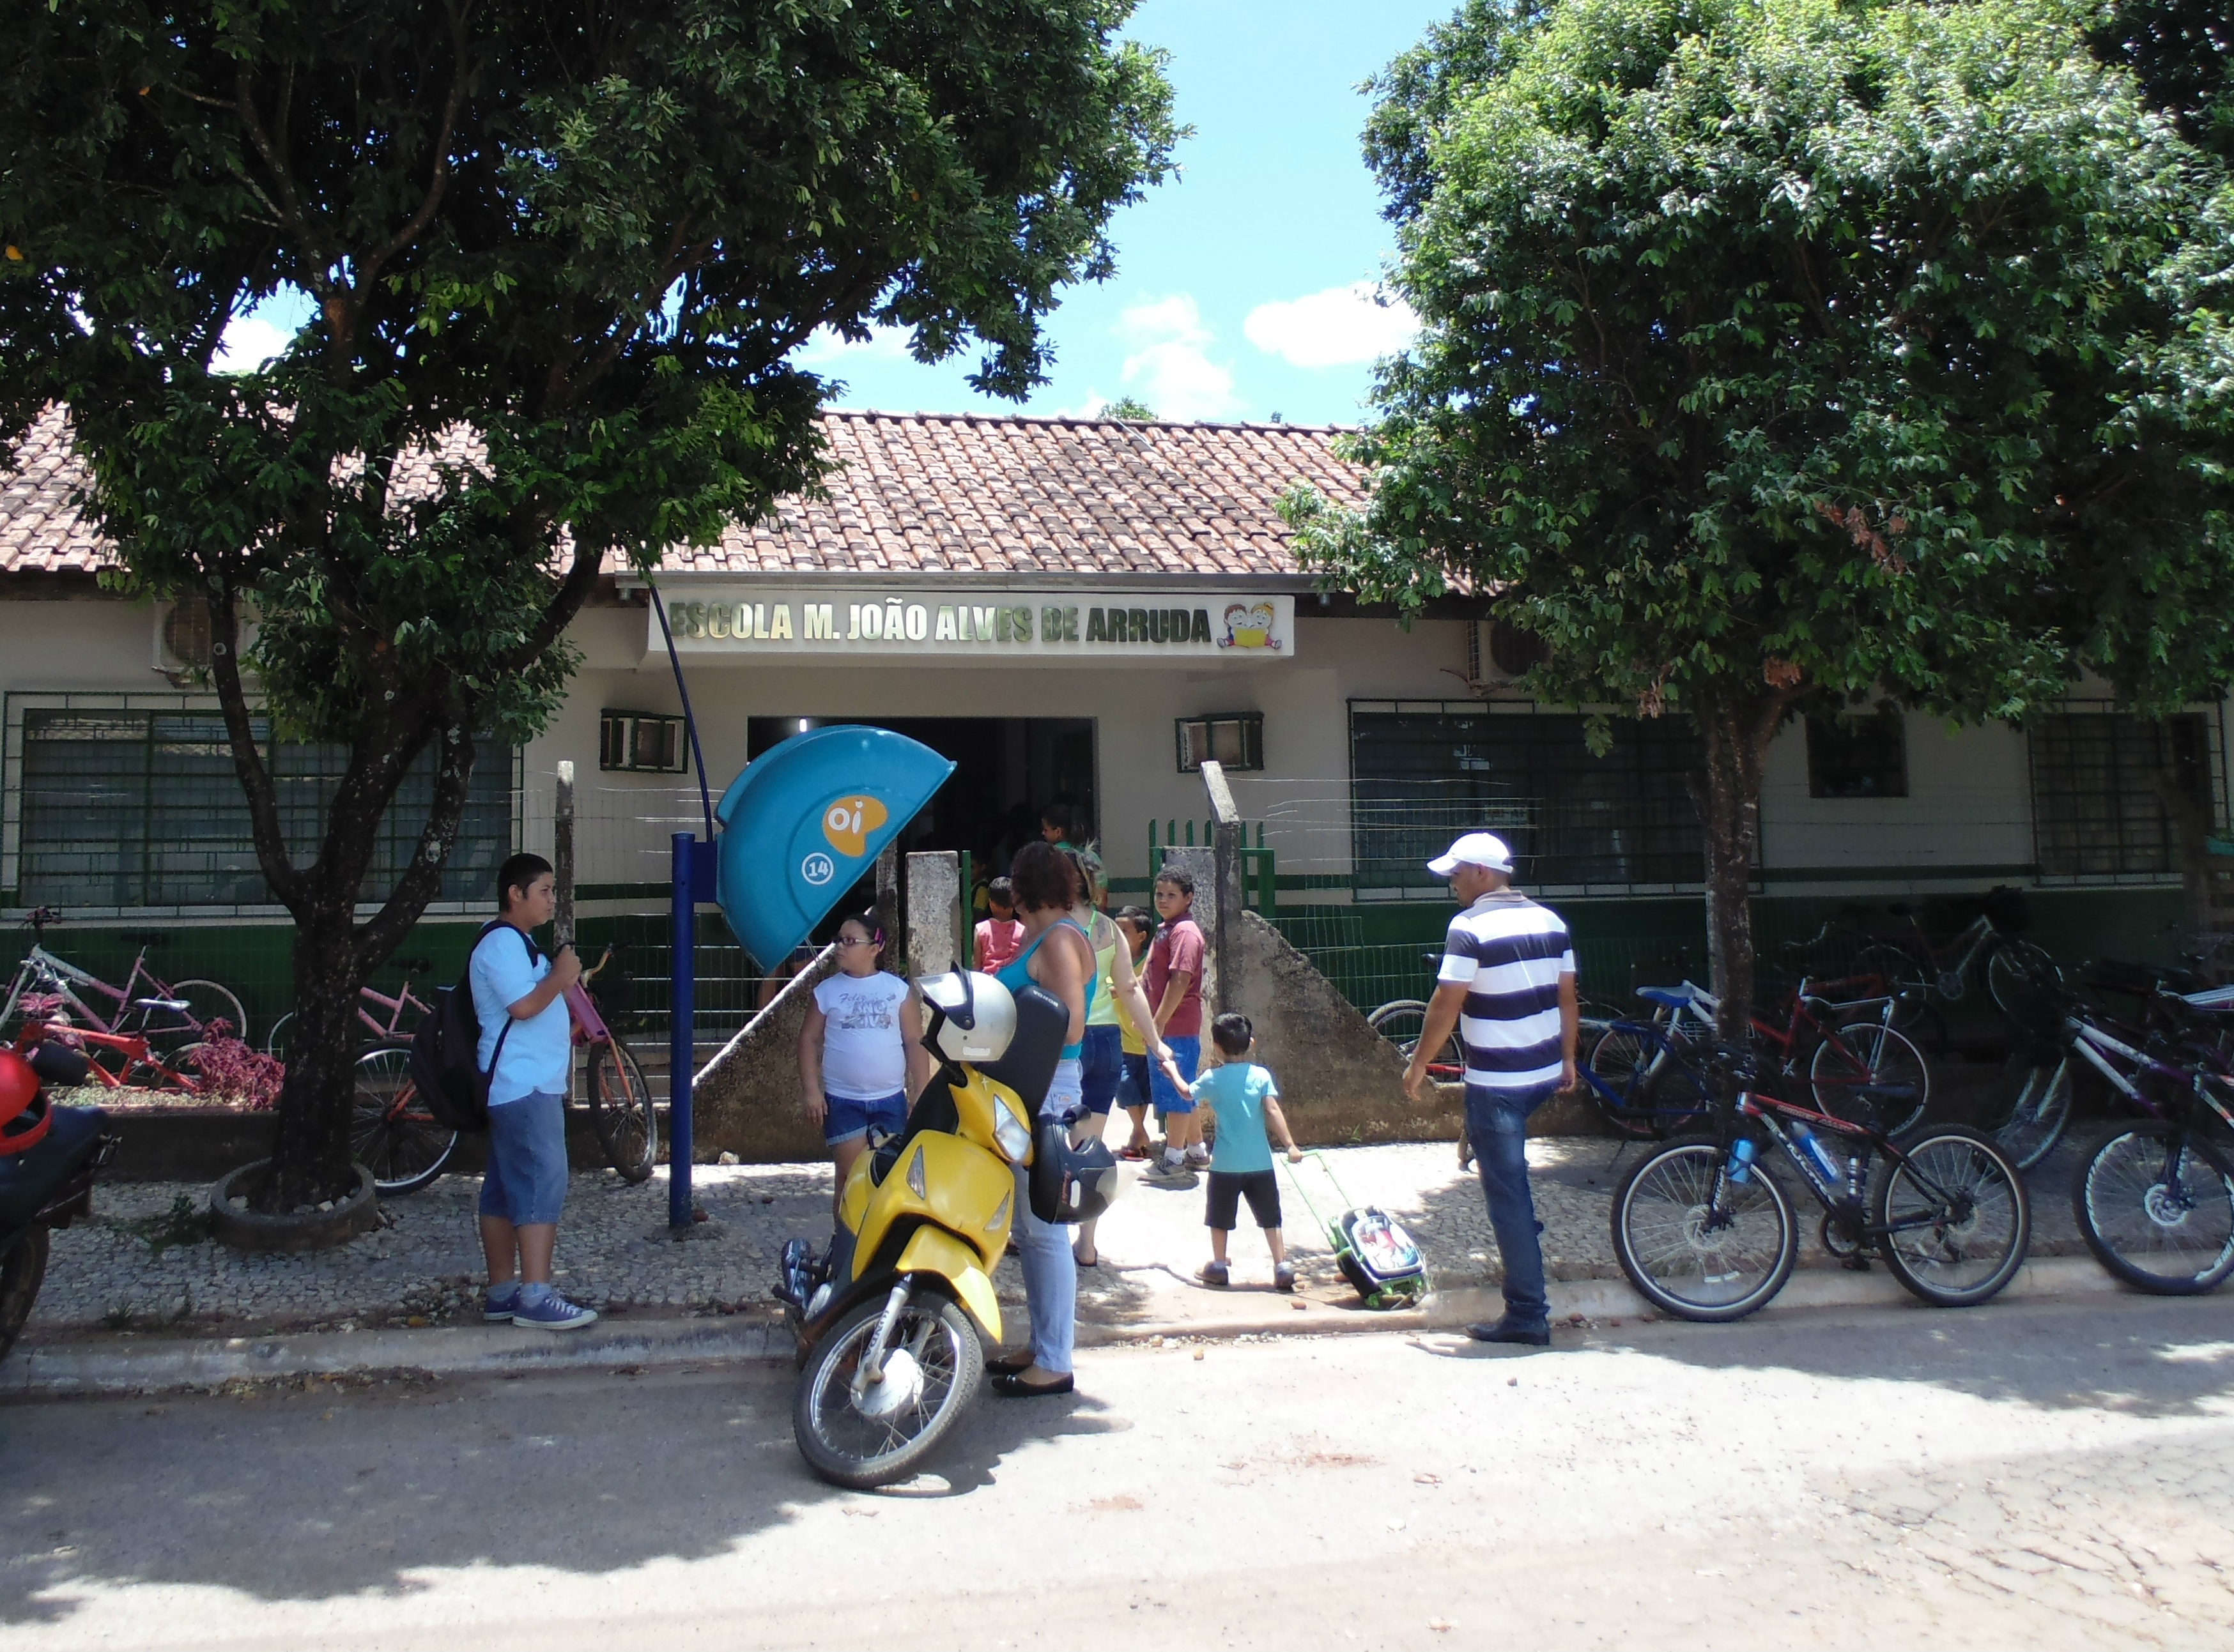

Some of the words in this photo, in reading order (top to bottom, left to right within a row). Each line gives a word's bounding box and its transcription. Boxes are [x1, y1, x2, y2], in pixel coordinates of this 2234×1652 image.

[670, 602, 794, 639] ESCOLA
[803, 603, 840, 639] M.
[847, 597, 927, 640] JOÃO
[935, 604, 1033, 641] ALVES
[1041, 606, 1079, 641] DE
[1086, 608, 1212, 643] ARRUDA
[808, 860, 829, 876] 14
[1033, 990, 1059, 1007] HONDA
